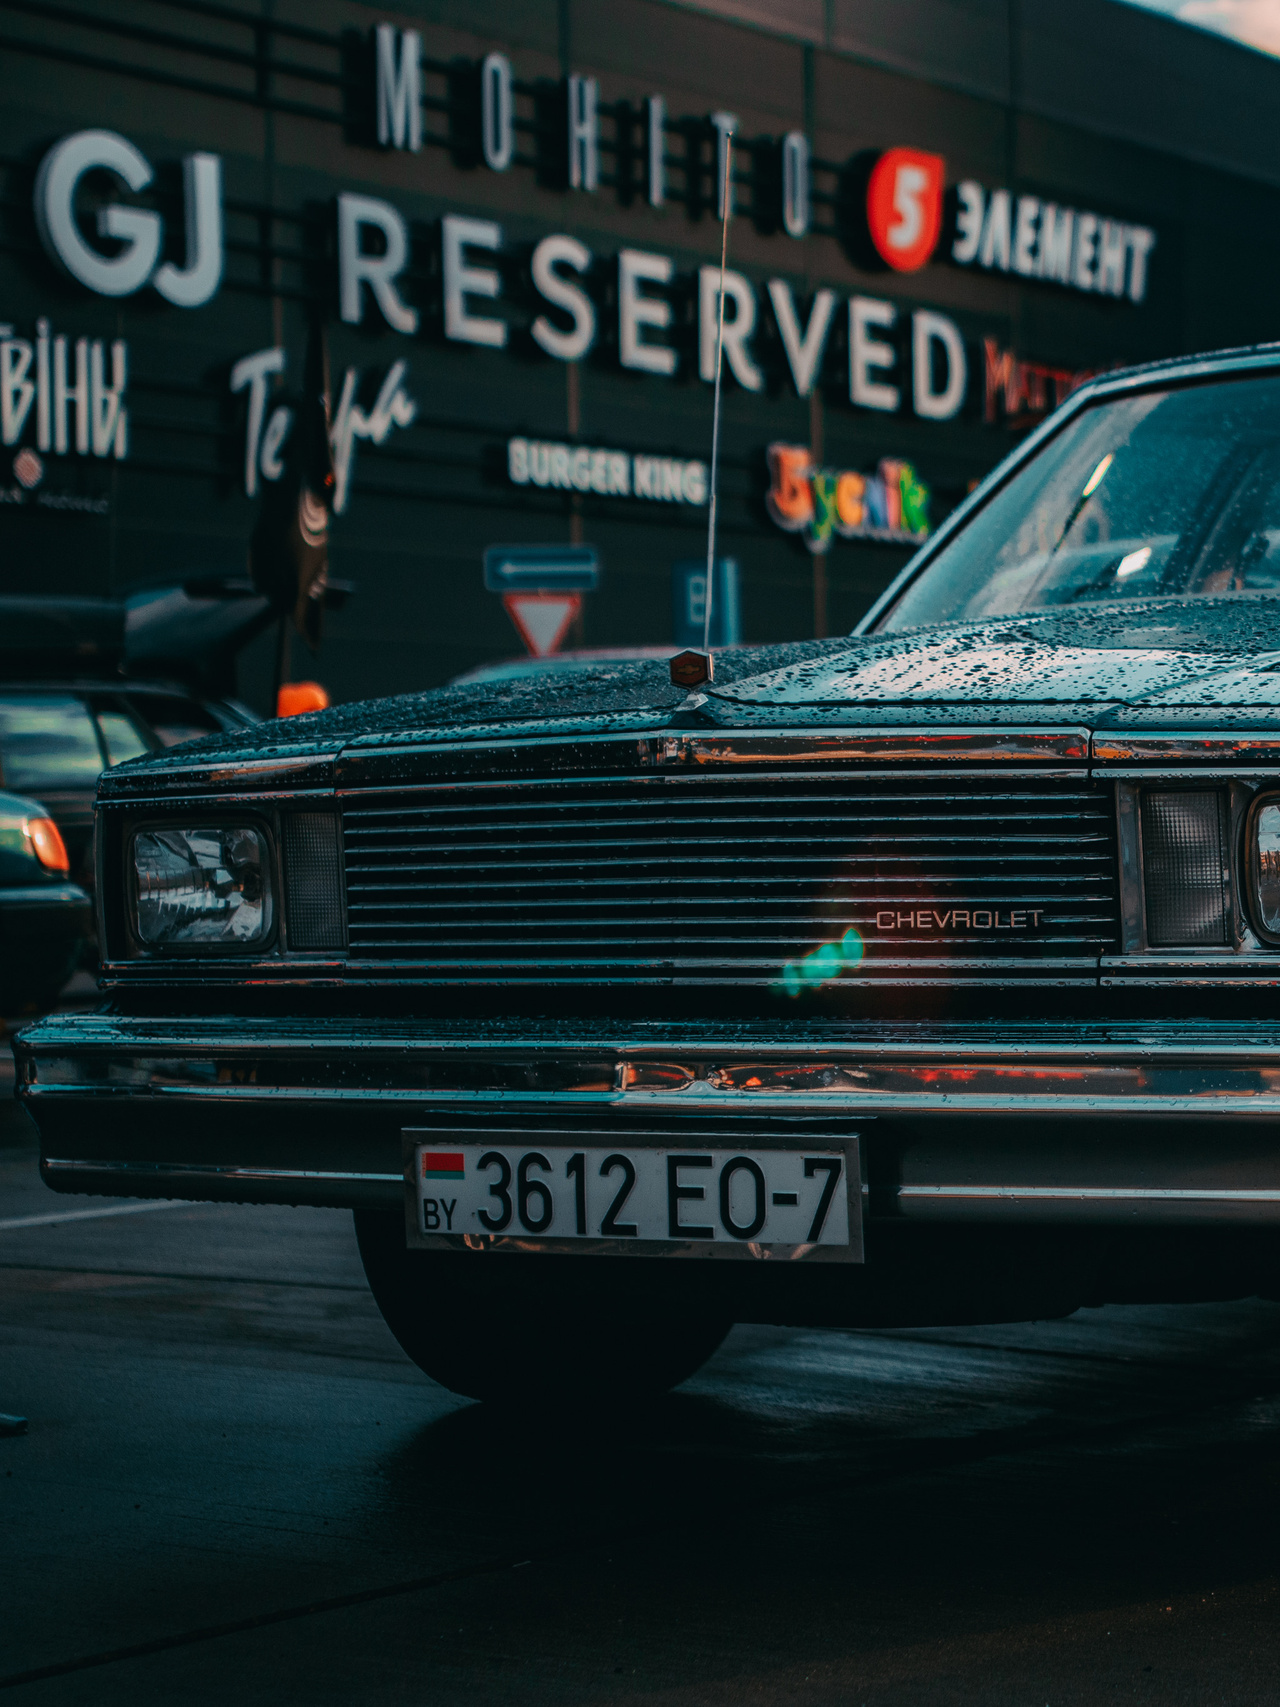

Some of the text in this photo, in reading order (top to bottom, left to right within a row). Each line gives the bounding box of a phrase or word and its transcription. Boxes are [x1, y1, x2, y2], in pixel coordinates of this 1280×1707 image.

[375, 22, 809, 237] MOHITO
[36, 128, 221, 307] GJ
[887, 162, 1156, 300] 5 ЭЛЕМЕНТ
[338, 192, 966, 420] RESERVED
[508, 437, 708, 506] BURGER KING
[876, 909, 1044, 929] CHEVROLET
[423, 1198, 457, 1231] BY
[476, 1151, 845, 1243] 3612 EO-7
